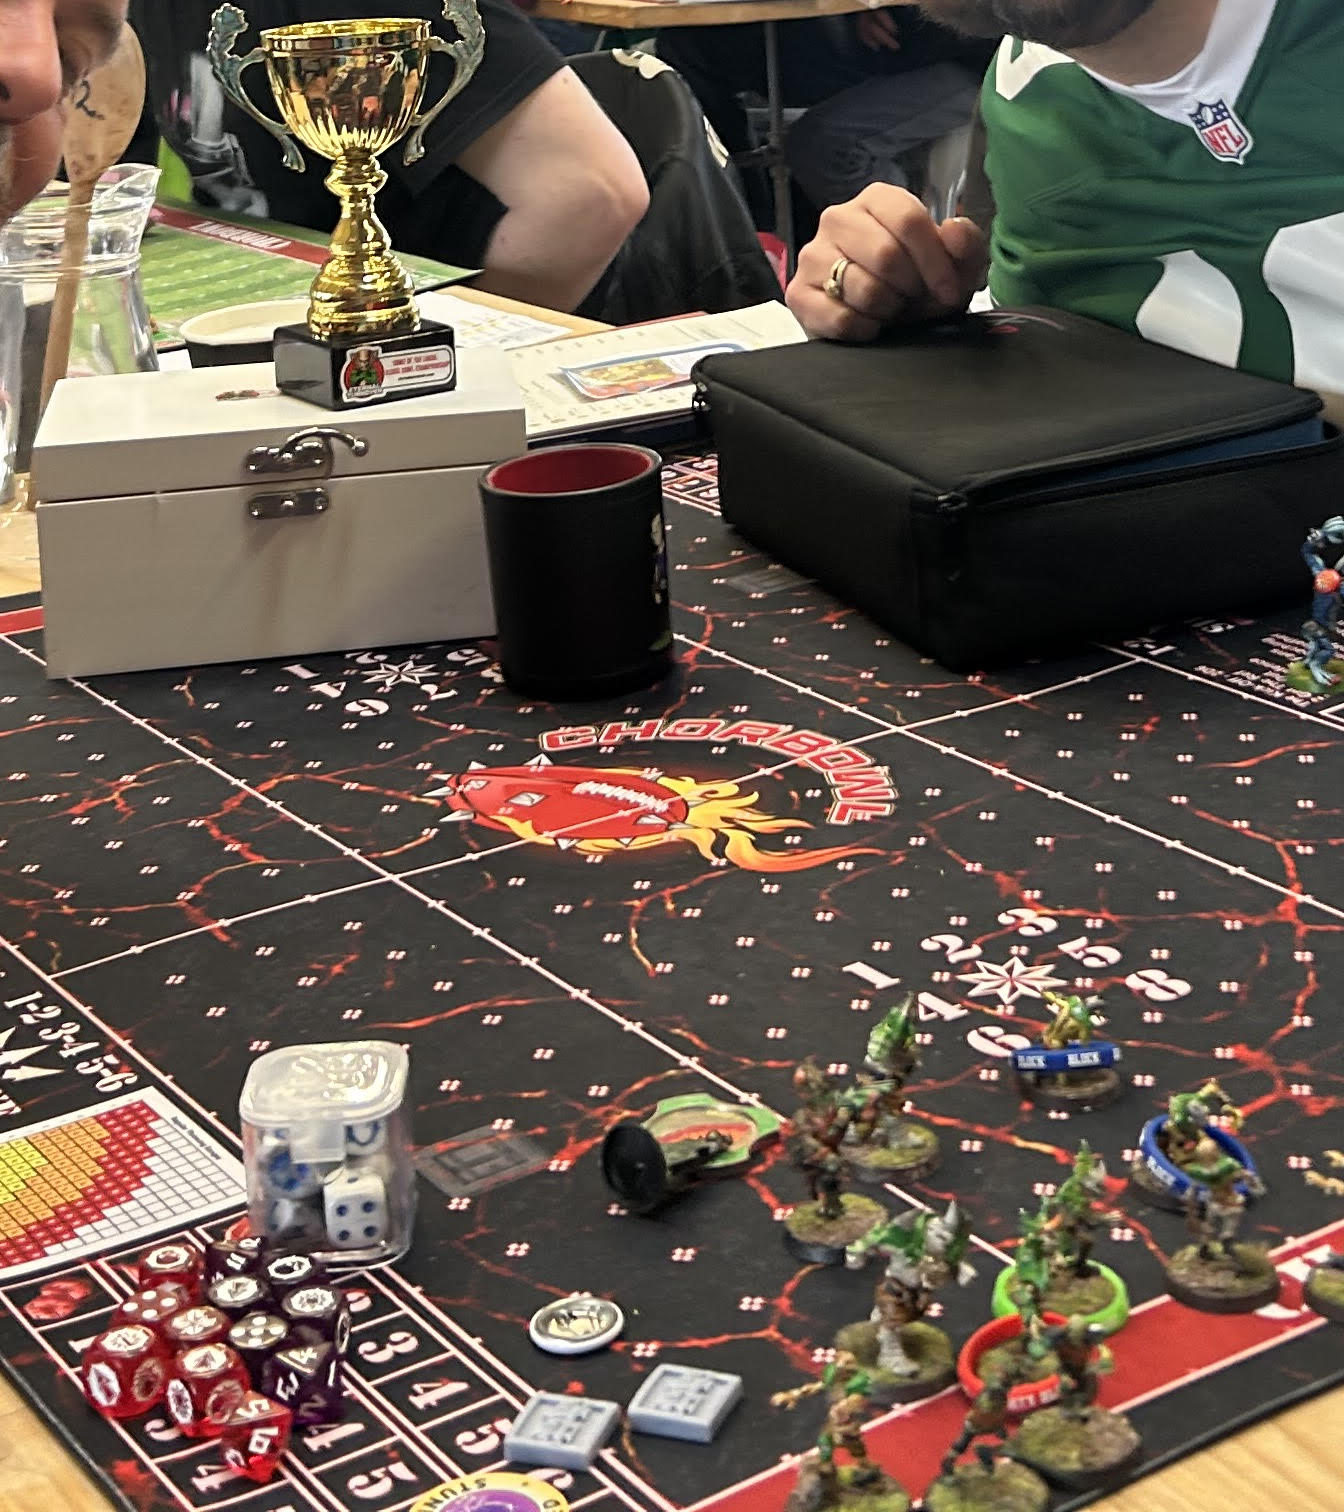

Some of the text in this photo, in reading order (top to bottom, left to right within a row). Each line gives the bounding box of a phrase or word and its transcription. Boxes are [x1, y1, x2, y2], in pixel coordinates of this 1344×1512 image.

[1202, 123, 1244, 154] NFL
[309, 681, 347, 699] 4
[540, 718, 899, 826] CHORBOWL
[998, 908, 1059, 936] 3
[920, 934, 984, 963] 2
[1058, 937, 1122, 968] 5
[842, 961, 901, 989] 1
[1125, 968, 1192, 1001] 8
[917, 991, 969, 1021] 4
[4, 991, 138, 1092] 1-2 3-4 5-6
[967, 1025, 1032, 1058] 6
[358, 1331, 419, 1363] 3
[408, 1381, 471, 1411] 4
[303, 1422, 366, 1452] 4
[455, 1418, 513, 1455] 5
[347, 1460, 418, 1499] 5
